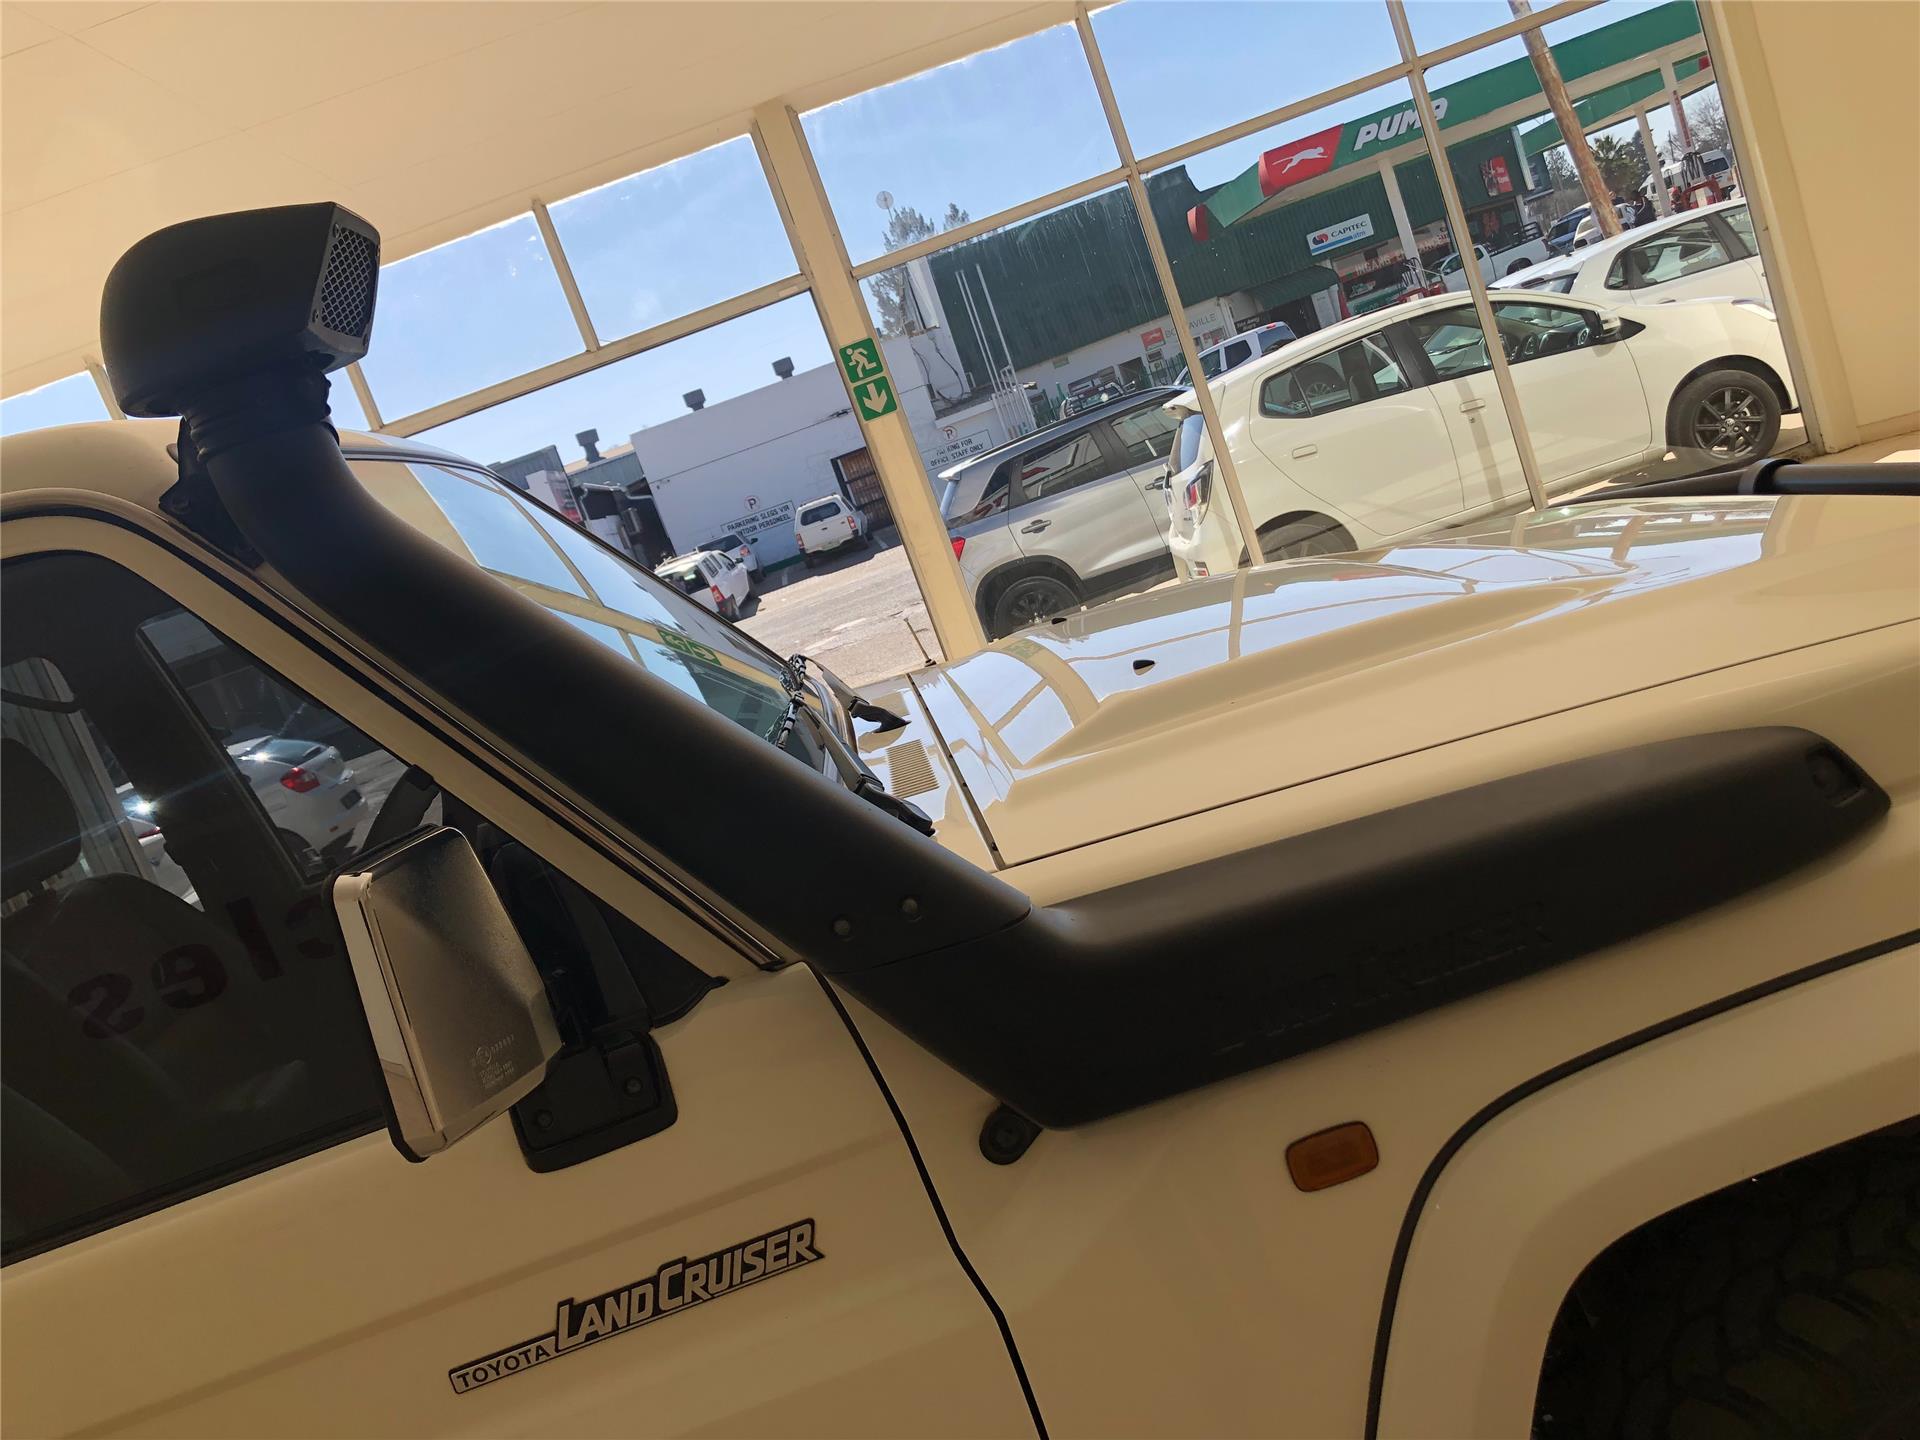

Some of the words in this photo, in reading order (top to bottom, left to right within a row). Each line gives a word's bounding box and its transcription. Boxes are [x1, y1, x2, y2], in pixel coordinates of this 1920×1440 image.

[1353, 97, 1448, 151] PUMA
[1331, 221, 1367, 238] CAPITEC
[1165, 313, 1217, 338] BOAVILLE
[951, 450, 969, 460] STAFF
[970, 442, 984, 453] ONLY
[961, 438, 973, 447] FOR
[727, 515, 760, 531] PARKERING
[760, 508, 779, 520] SLEGS
[780, 504, 790, 513] VIR
[737, 523, 757, 535] NTOOR
[758, 513, 791, 529] PERSONEEL
[456, 1344, 551, 1388] TOYOTA
